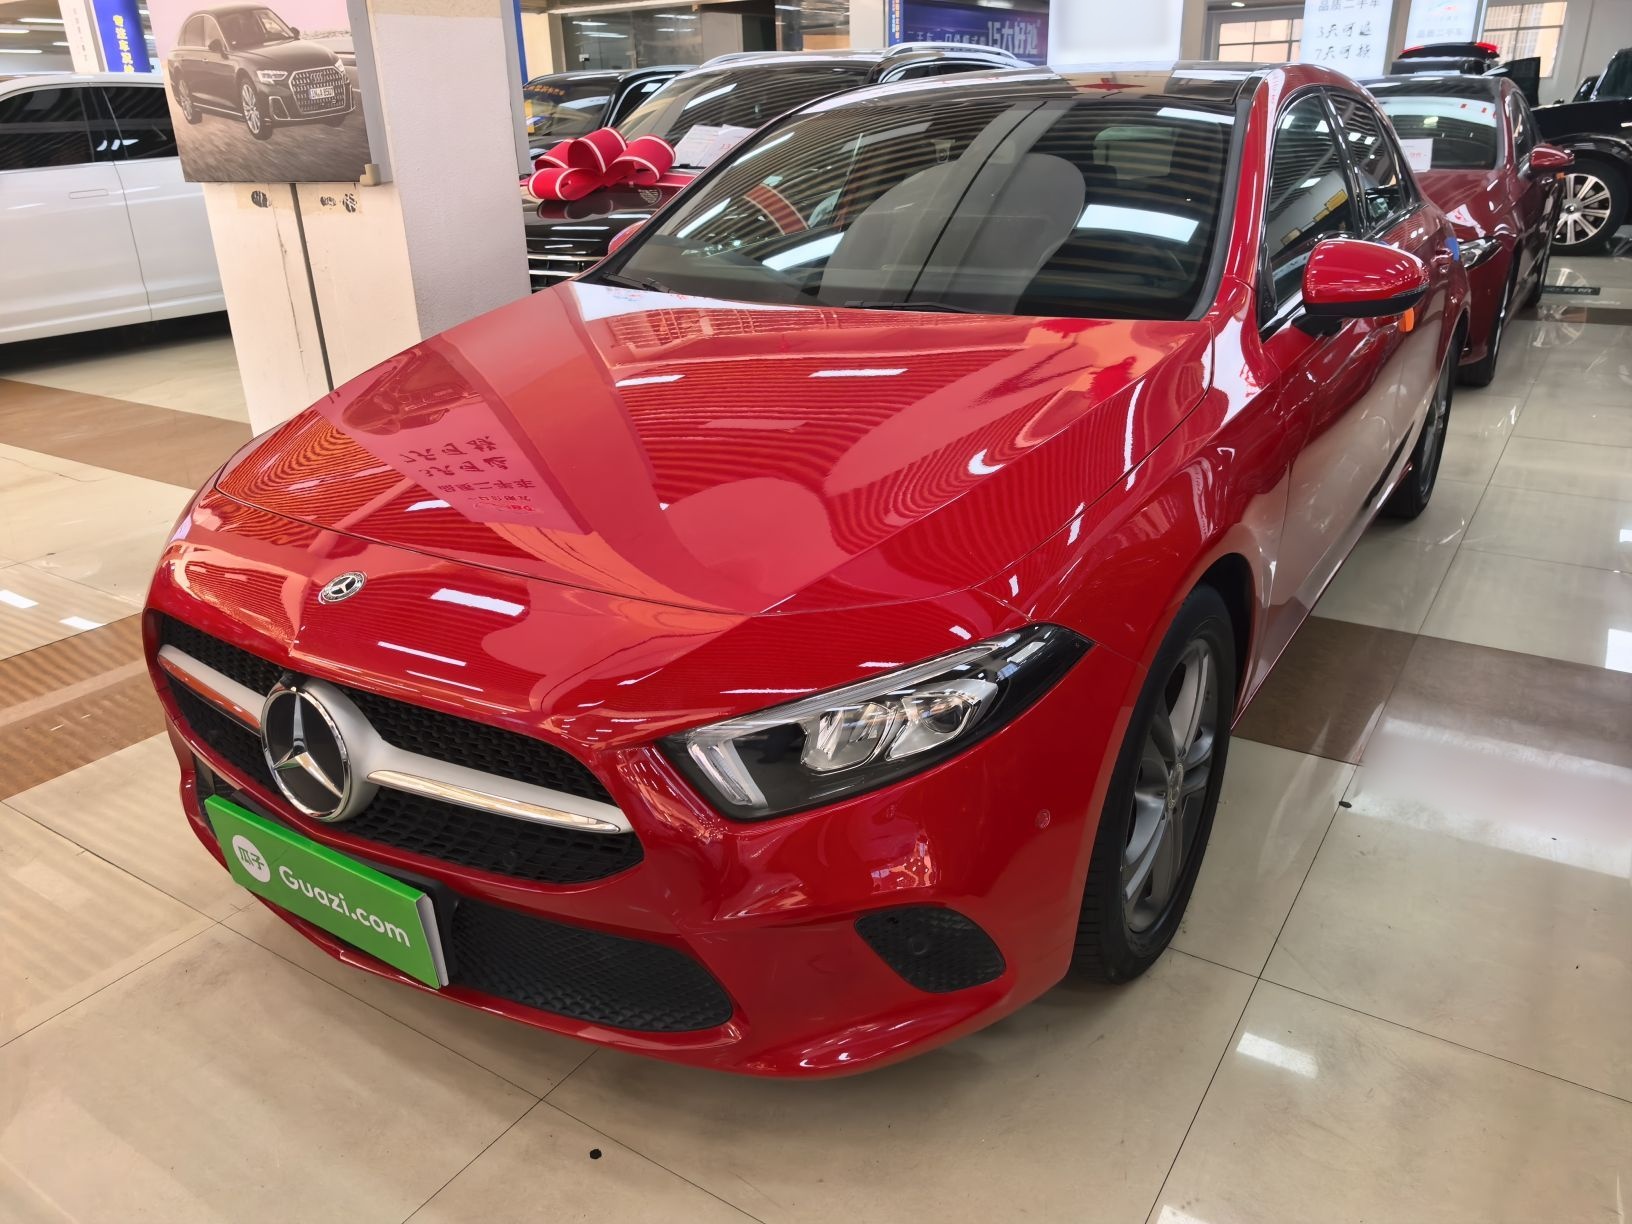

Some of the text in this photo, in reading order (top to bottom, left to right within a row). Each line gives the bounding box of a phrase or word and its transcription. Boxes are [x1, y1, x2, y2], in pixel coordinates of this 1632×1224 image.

[1317, 21, 1373, 38] 3天可退
[278, 865, 411, 948] Guazi.com
